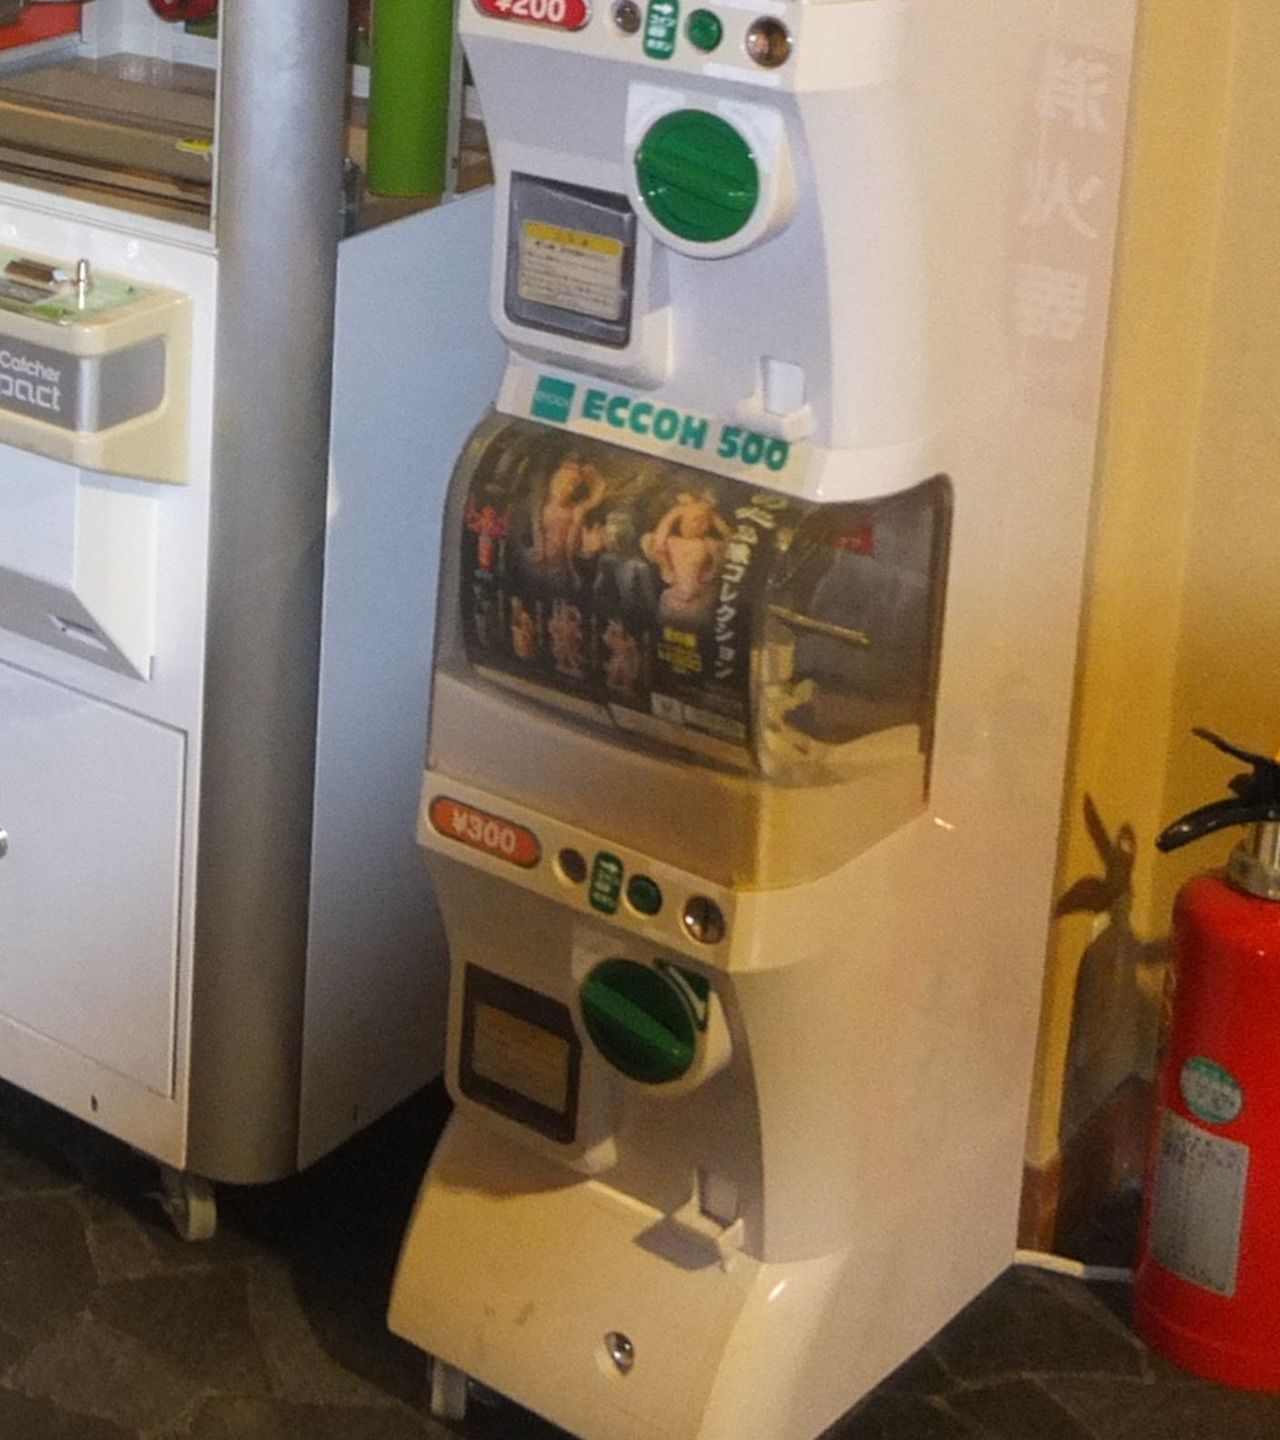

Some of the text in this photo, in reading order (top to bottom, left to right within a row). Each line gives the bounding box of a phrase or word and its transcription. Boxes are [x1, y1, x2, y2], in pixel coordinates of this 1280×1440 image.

[581, 387, 790, 472] ECCOH 500
[452, 807, 517, 855] ¥300
